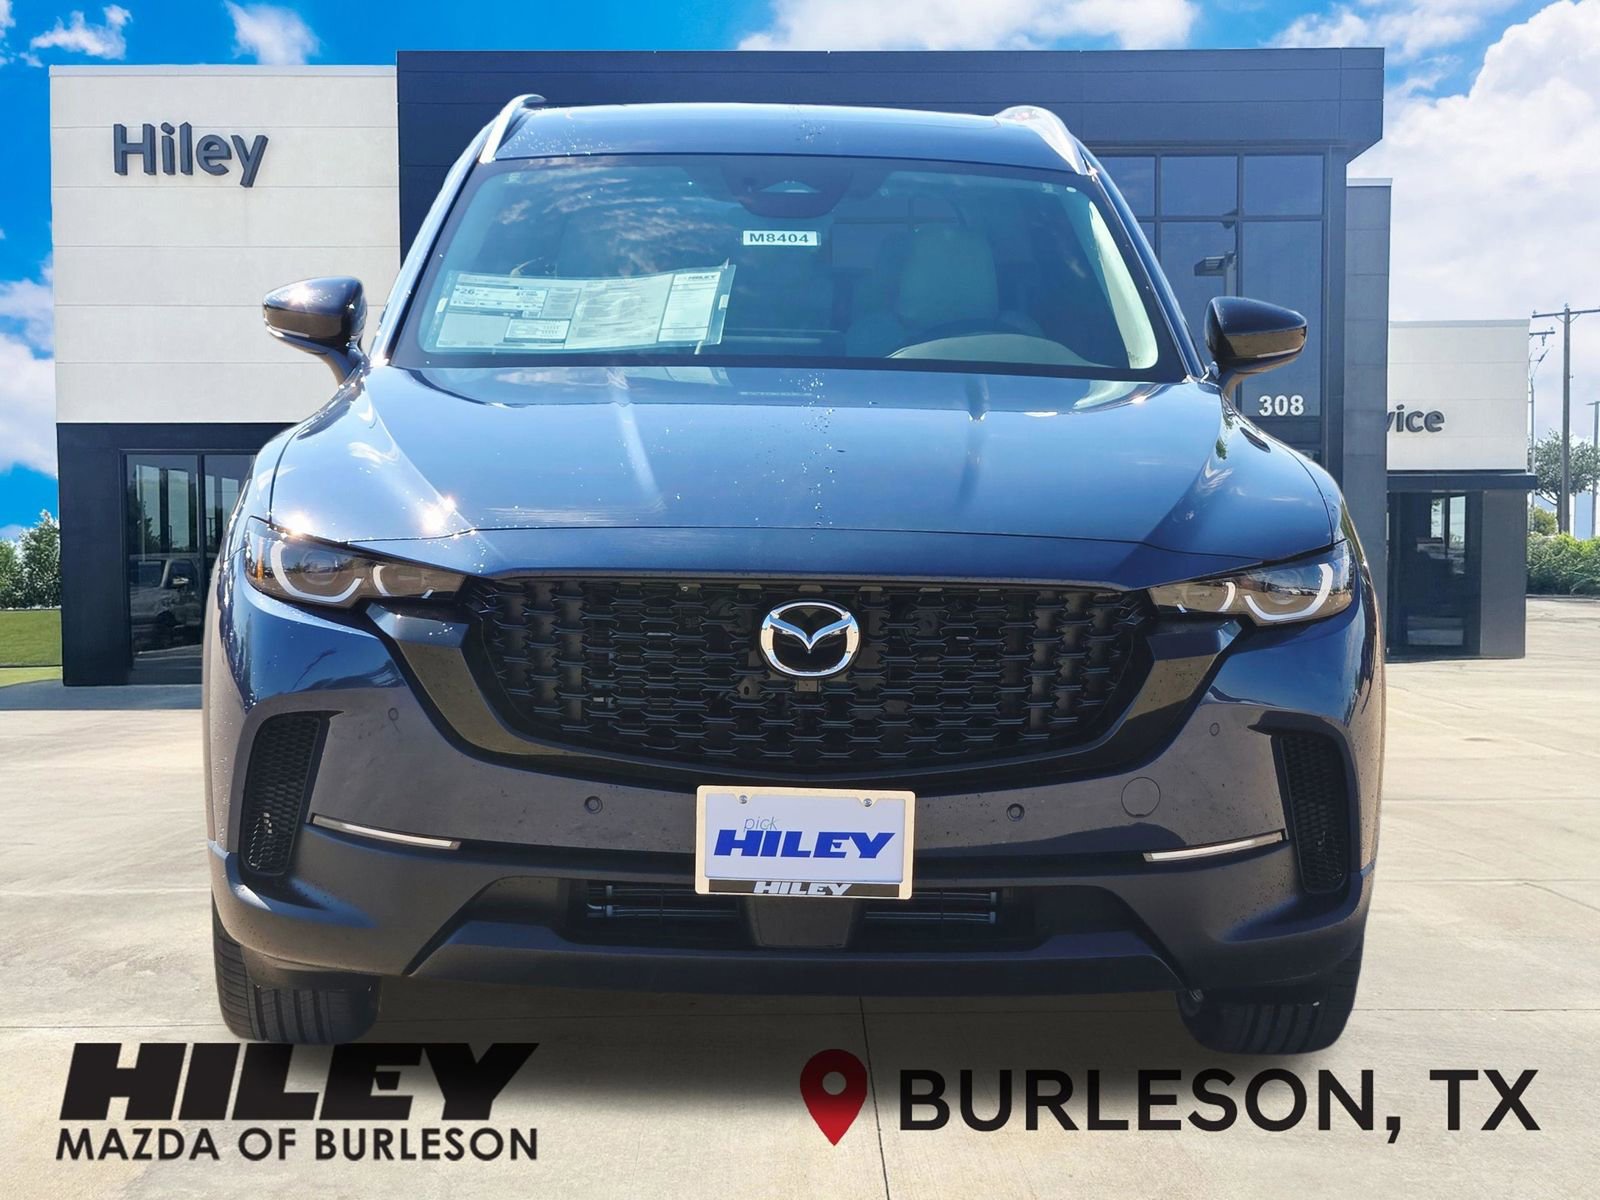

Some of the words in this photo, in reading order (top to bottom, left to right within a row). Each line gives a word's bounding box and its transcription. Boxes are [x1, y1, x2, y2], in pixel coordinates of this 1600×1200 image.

[113, 122, 269, 188] Hiley
[749, 232, 809, 243] M8404
[1258, 395, 1305, 417] 308
[743, 816, 778, 832] pick
[714, 829, 896, 859] HILEY
[753, 881, 853, 896] HILEY
